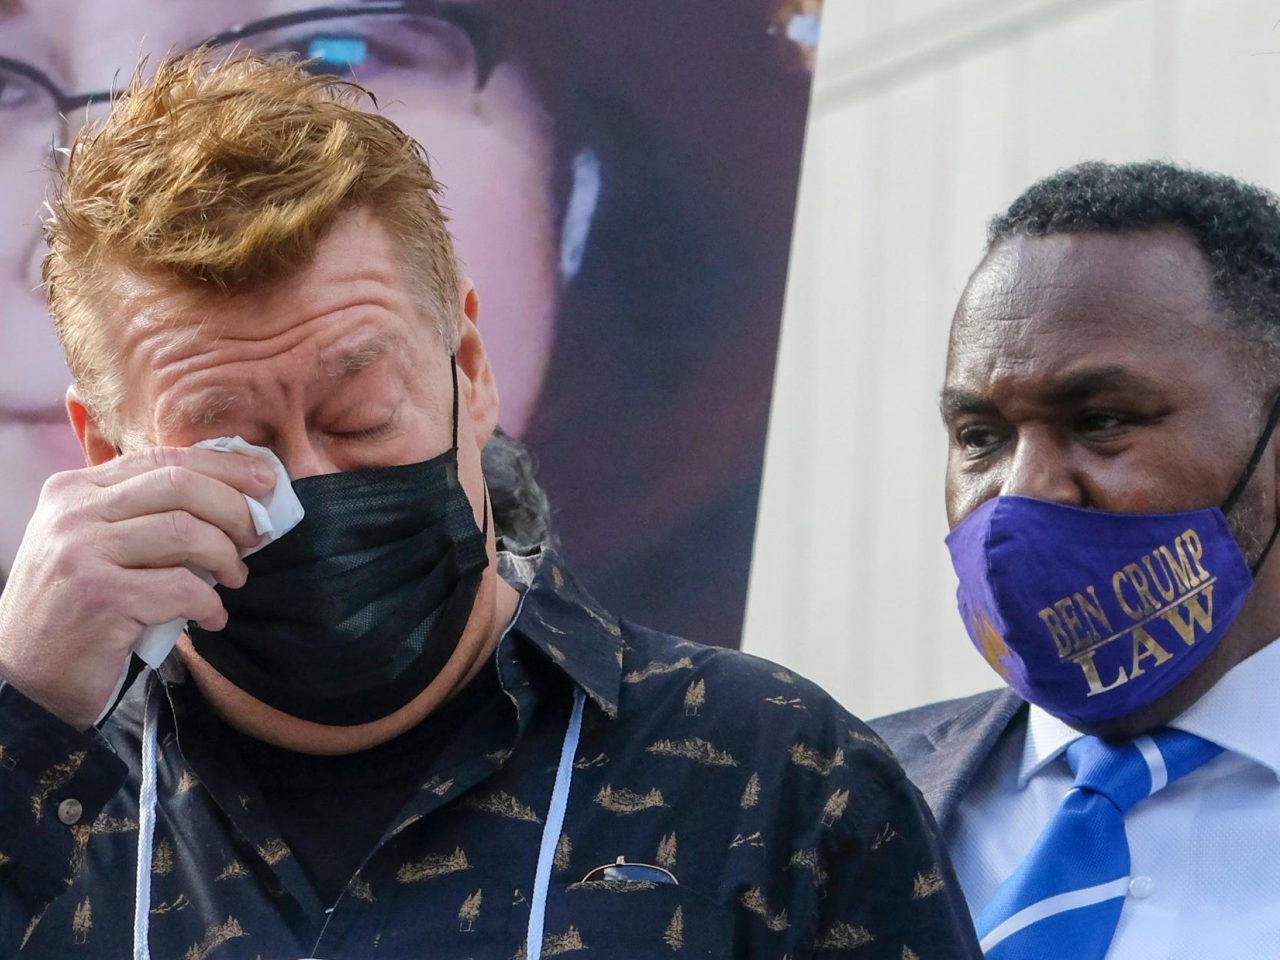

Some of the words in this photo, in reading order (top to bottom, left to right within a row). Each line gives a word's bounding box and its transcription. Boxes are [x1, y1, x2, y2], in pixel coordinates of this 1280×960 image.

[1037, 585, 1114, 657] BEN
[1112, 528, 1211, 621] CRUMP
[1073, 584, 1215, 697] LAW
